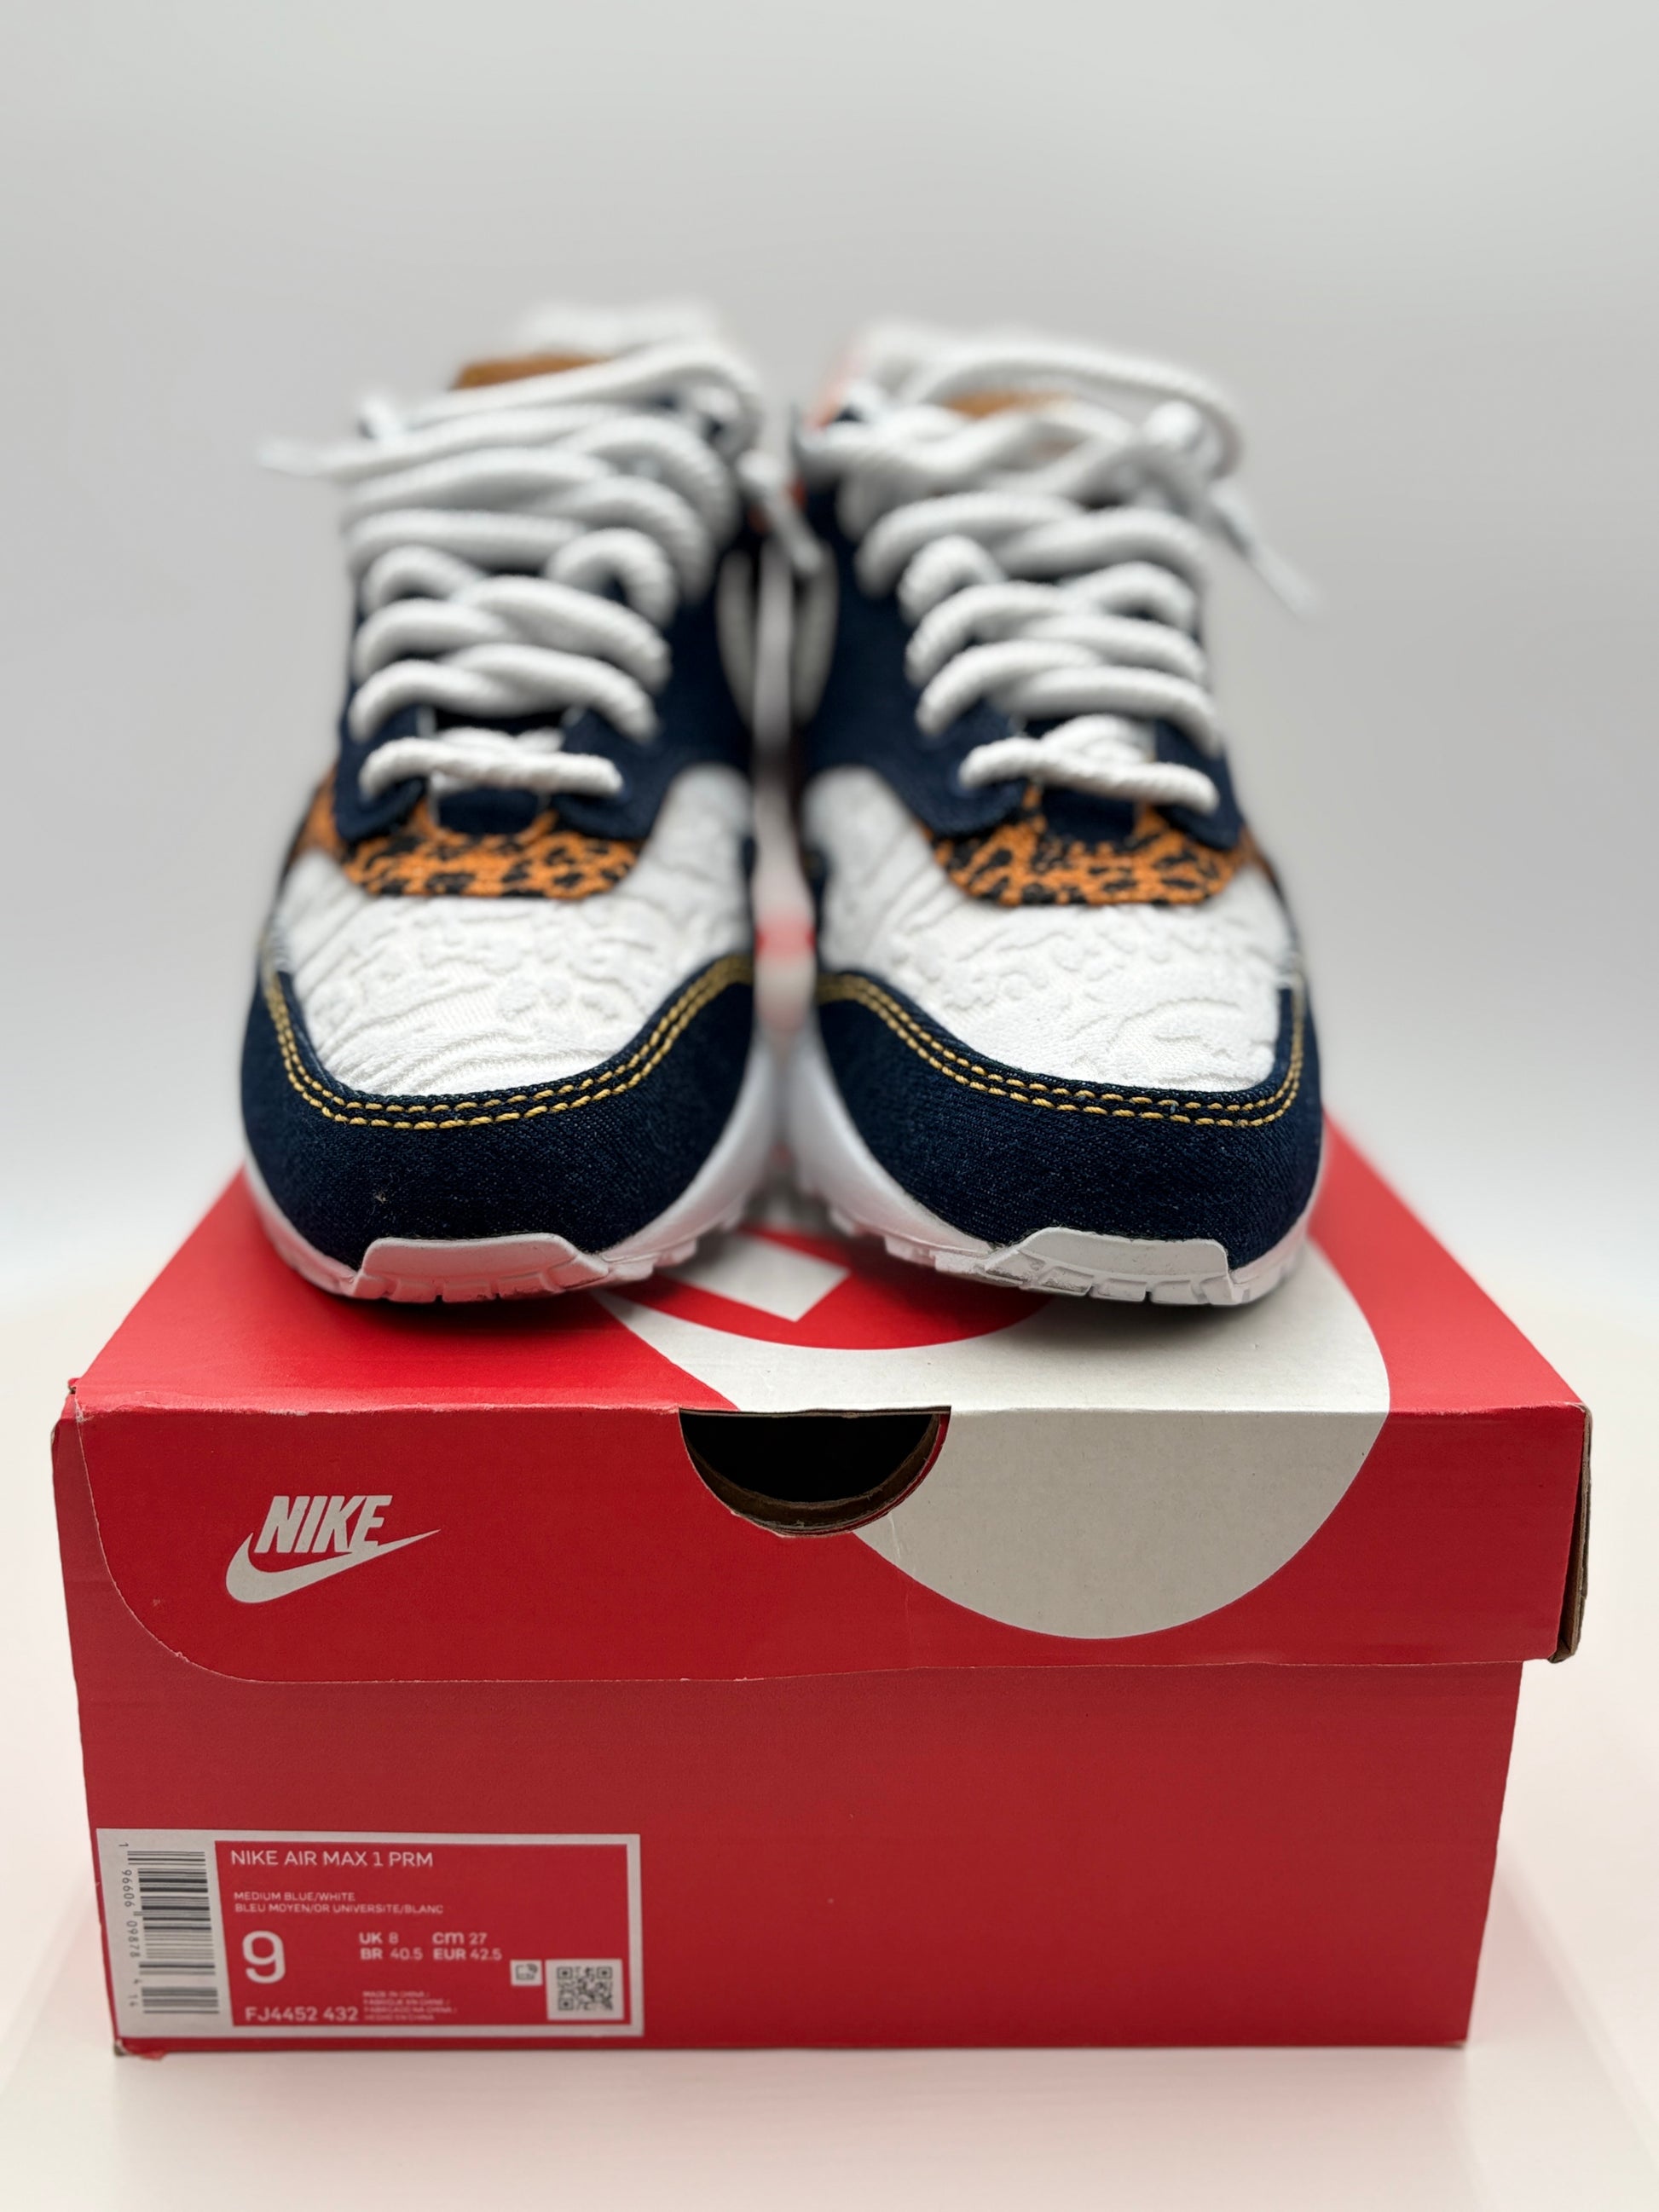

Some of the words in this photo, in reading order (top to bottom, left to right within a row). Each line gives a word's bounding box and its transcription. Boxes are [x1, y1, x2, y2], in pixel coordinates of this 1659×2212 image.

[254, 1495, 392, 1553] NIKE
[231, 1850, 279, 1865] NIKE
[284, 1851, 318, 1866] AIR
[323, 1851, 367, 1866] MAX
[373, 1851, 384, 1866] 1
[389, 1851, 433, 1867] PRM
[122, 1869, 136, 1908] 96606
[234, 1891, 281, 1902] MEDIUM
[284, 1892, 356, 1902] BLUE/WHITE
[234, 1903, 266, 1913] BLEU
[269, 1903, 330, 1914] MOYEN/OR
[332, 1903, 443, 1914] UNIVERSITE/BLANC
[359, 1932, 383, 1944] UK
[389, 1932, 399, 1944] 8
[432, 1932, 465, 1944] cm
[469, 1932, 488, 1945] 27
[242, 1930, 286, 1984] 9
[361, 1948, 383, 1960] BR
[390, 1947, 423, 1961] 40.5
[433, 1948, 466, 1961] EUR
[470, 1948, 502, 1961] 42.5
[245, 2006, 318, 2022] FJ4452
[323, 2006, 359, 2022] 432
